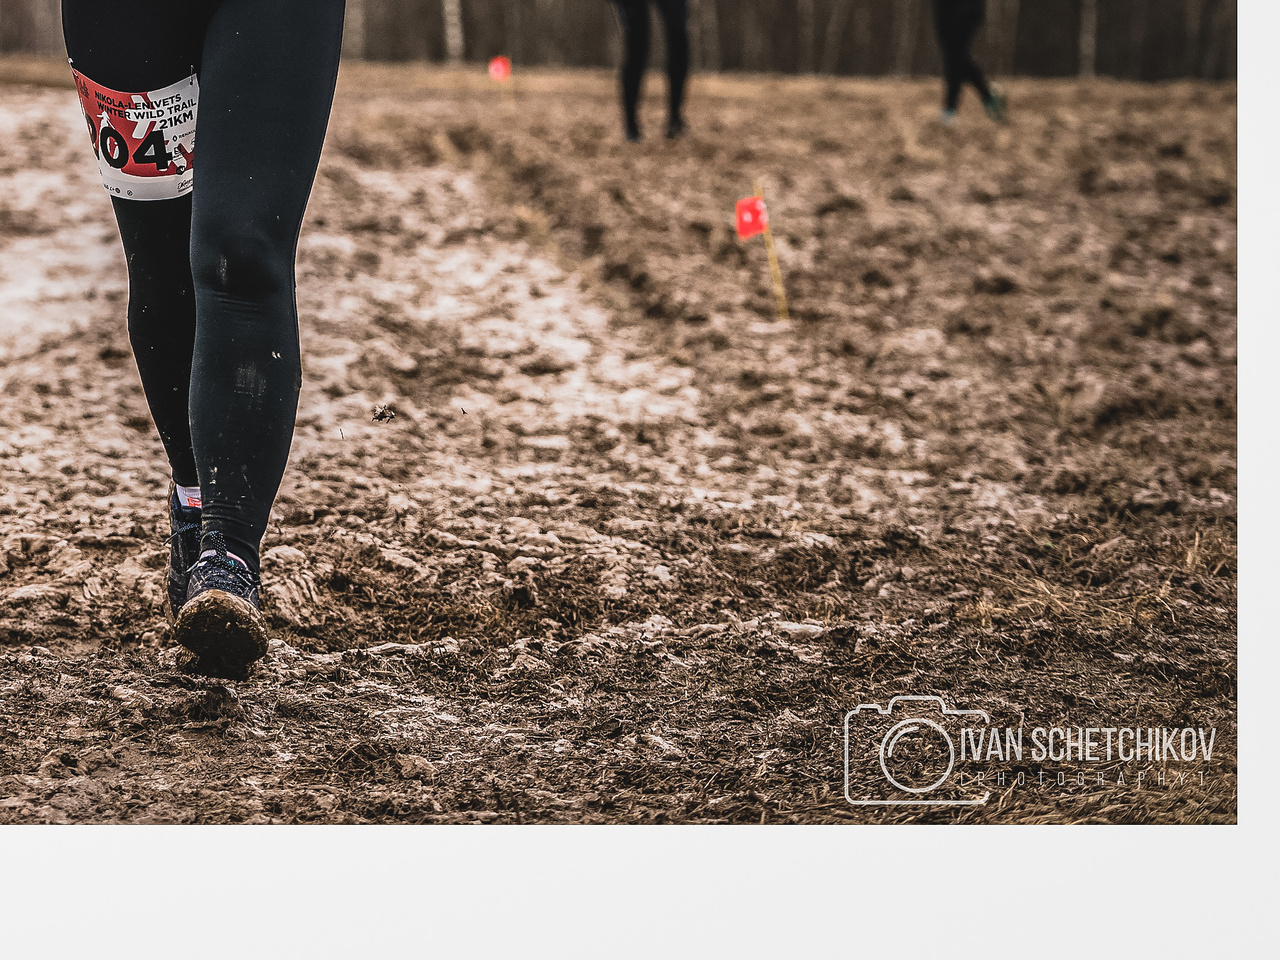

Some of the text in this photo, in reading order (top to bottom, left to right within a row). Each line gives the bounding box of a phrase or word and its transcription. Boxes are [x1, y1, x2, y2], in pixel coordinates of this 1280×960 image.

[94, 91, 181, 110] NIKOLA-LENIVETS
[96, 98, 197, 120] WINTER WILD TRAIL
[159, 110, 194, 130] 21KM
